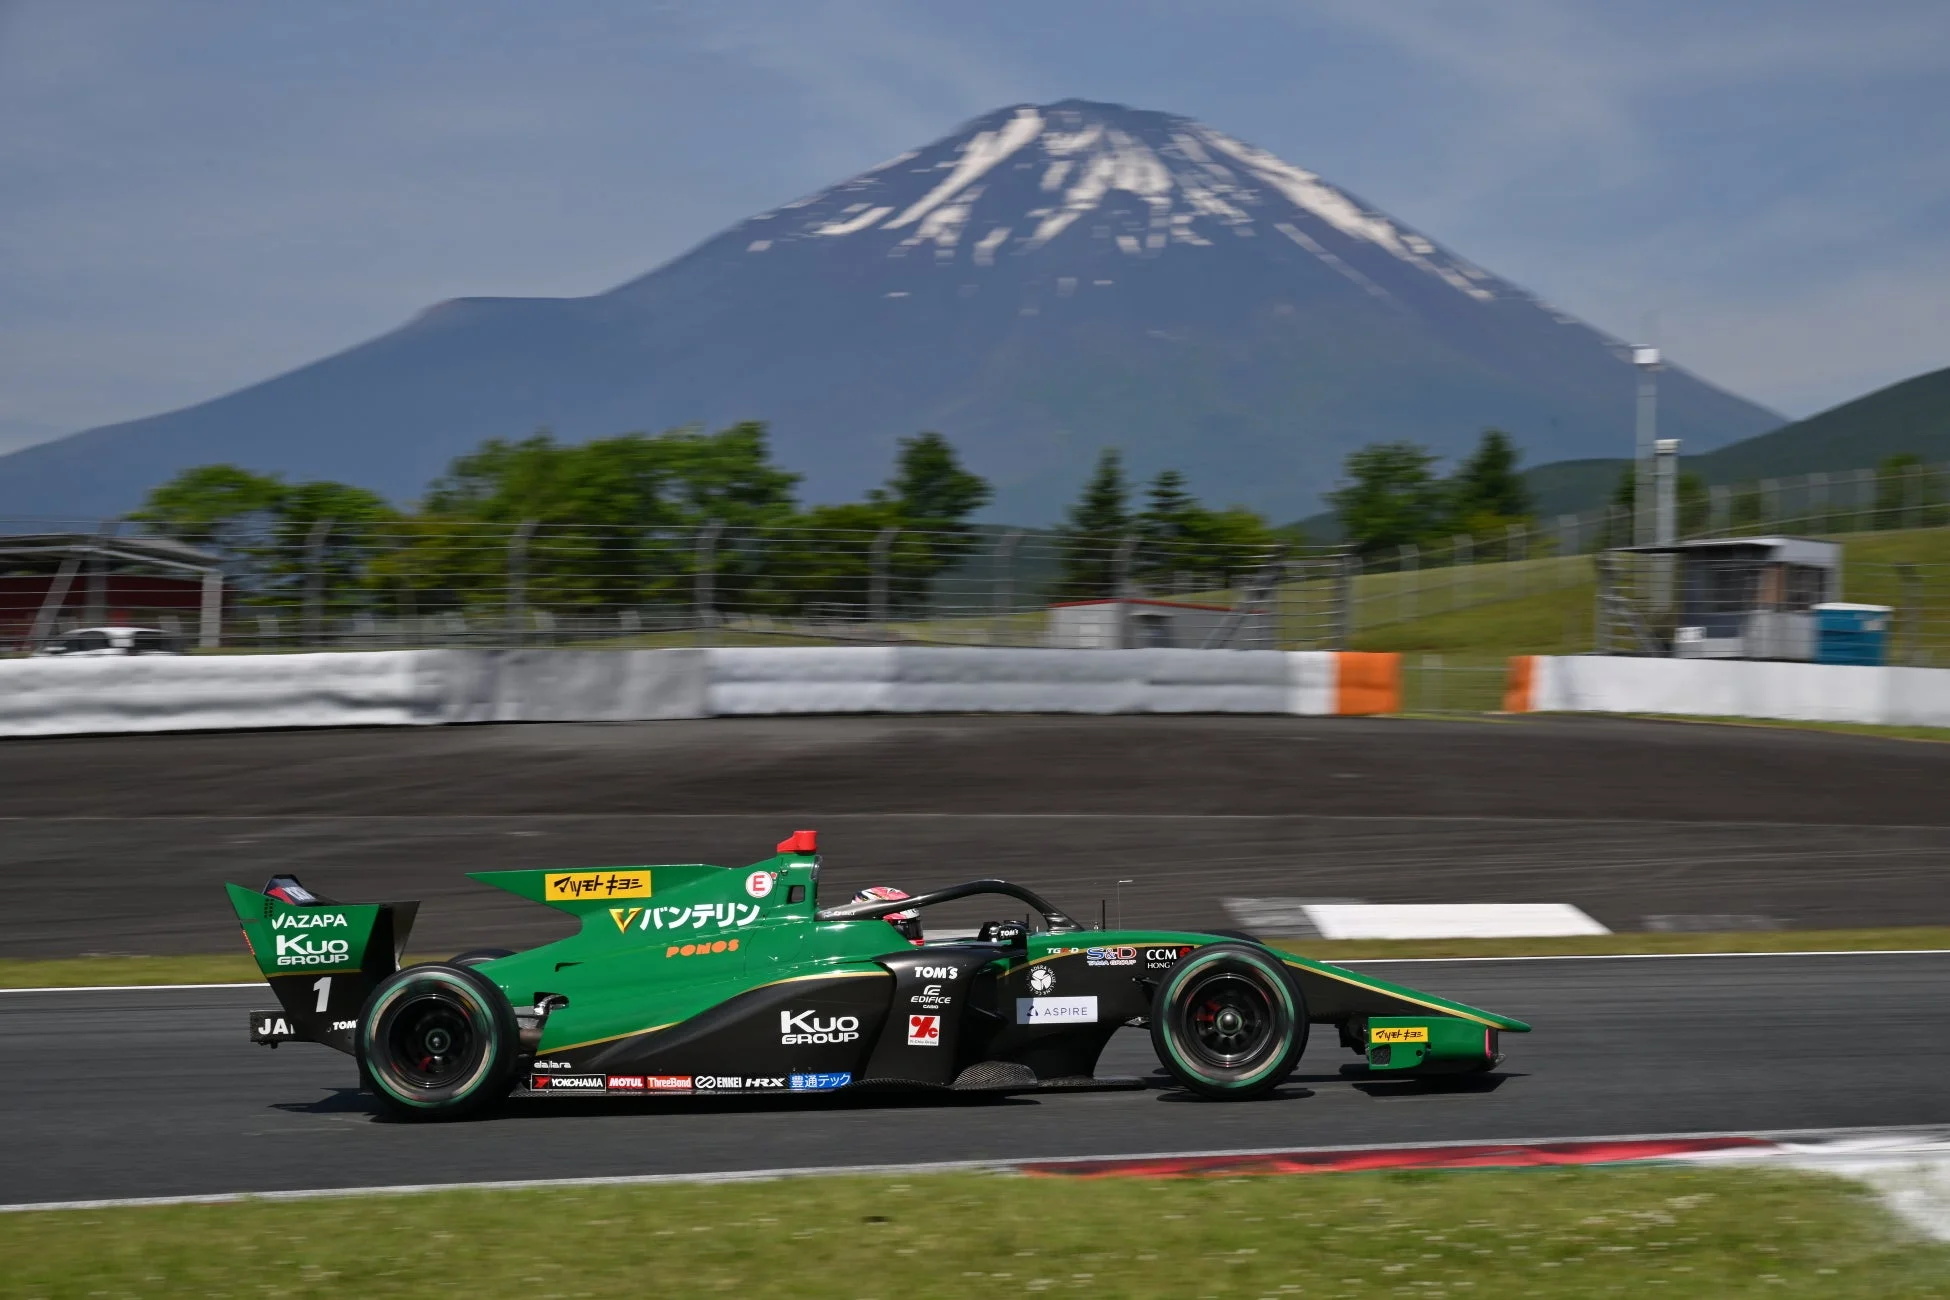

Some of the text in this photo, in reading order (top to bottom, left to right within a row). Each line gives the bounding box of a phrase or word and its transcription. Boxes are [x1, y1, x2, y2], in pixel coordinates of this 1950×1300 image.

[753, 875, 765, 891] E
[284, 914, 347, 928] AZAPA
[640, 903, 760, 931] バンテリン
[1087, 947, 1137, 960] S&D
[1146, 949, 1177, 960] CCM
[277, 954, 349, 966] GROUP
[914, 966, 958, 979] TOM'S
[313, 977, 332, 1013] 1
[911, 995, 951, 1004] EDIFICE
[1044, 1006, 1088, 1016] ASPIRE
[782, 1032, 859, 1045] GROUP
[551, 1078, 603, 1087] YOKOHAMA
[609, 1078, 643, 1087] MOTUL
[648, 1077, 691, 1088] ThreeBond
[717, 1077, 742, 1088] ENKEI
[745, 1078, 785, 1088] HRX
[791, 1074, 850, 1088] 豊通テック
